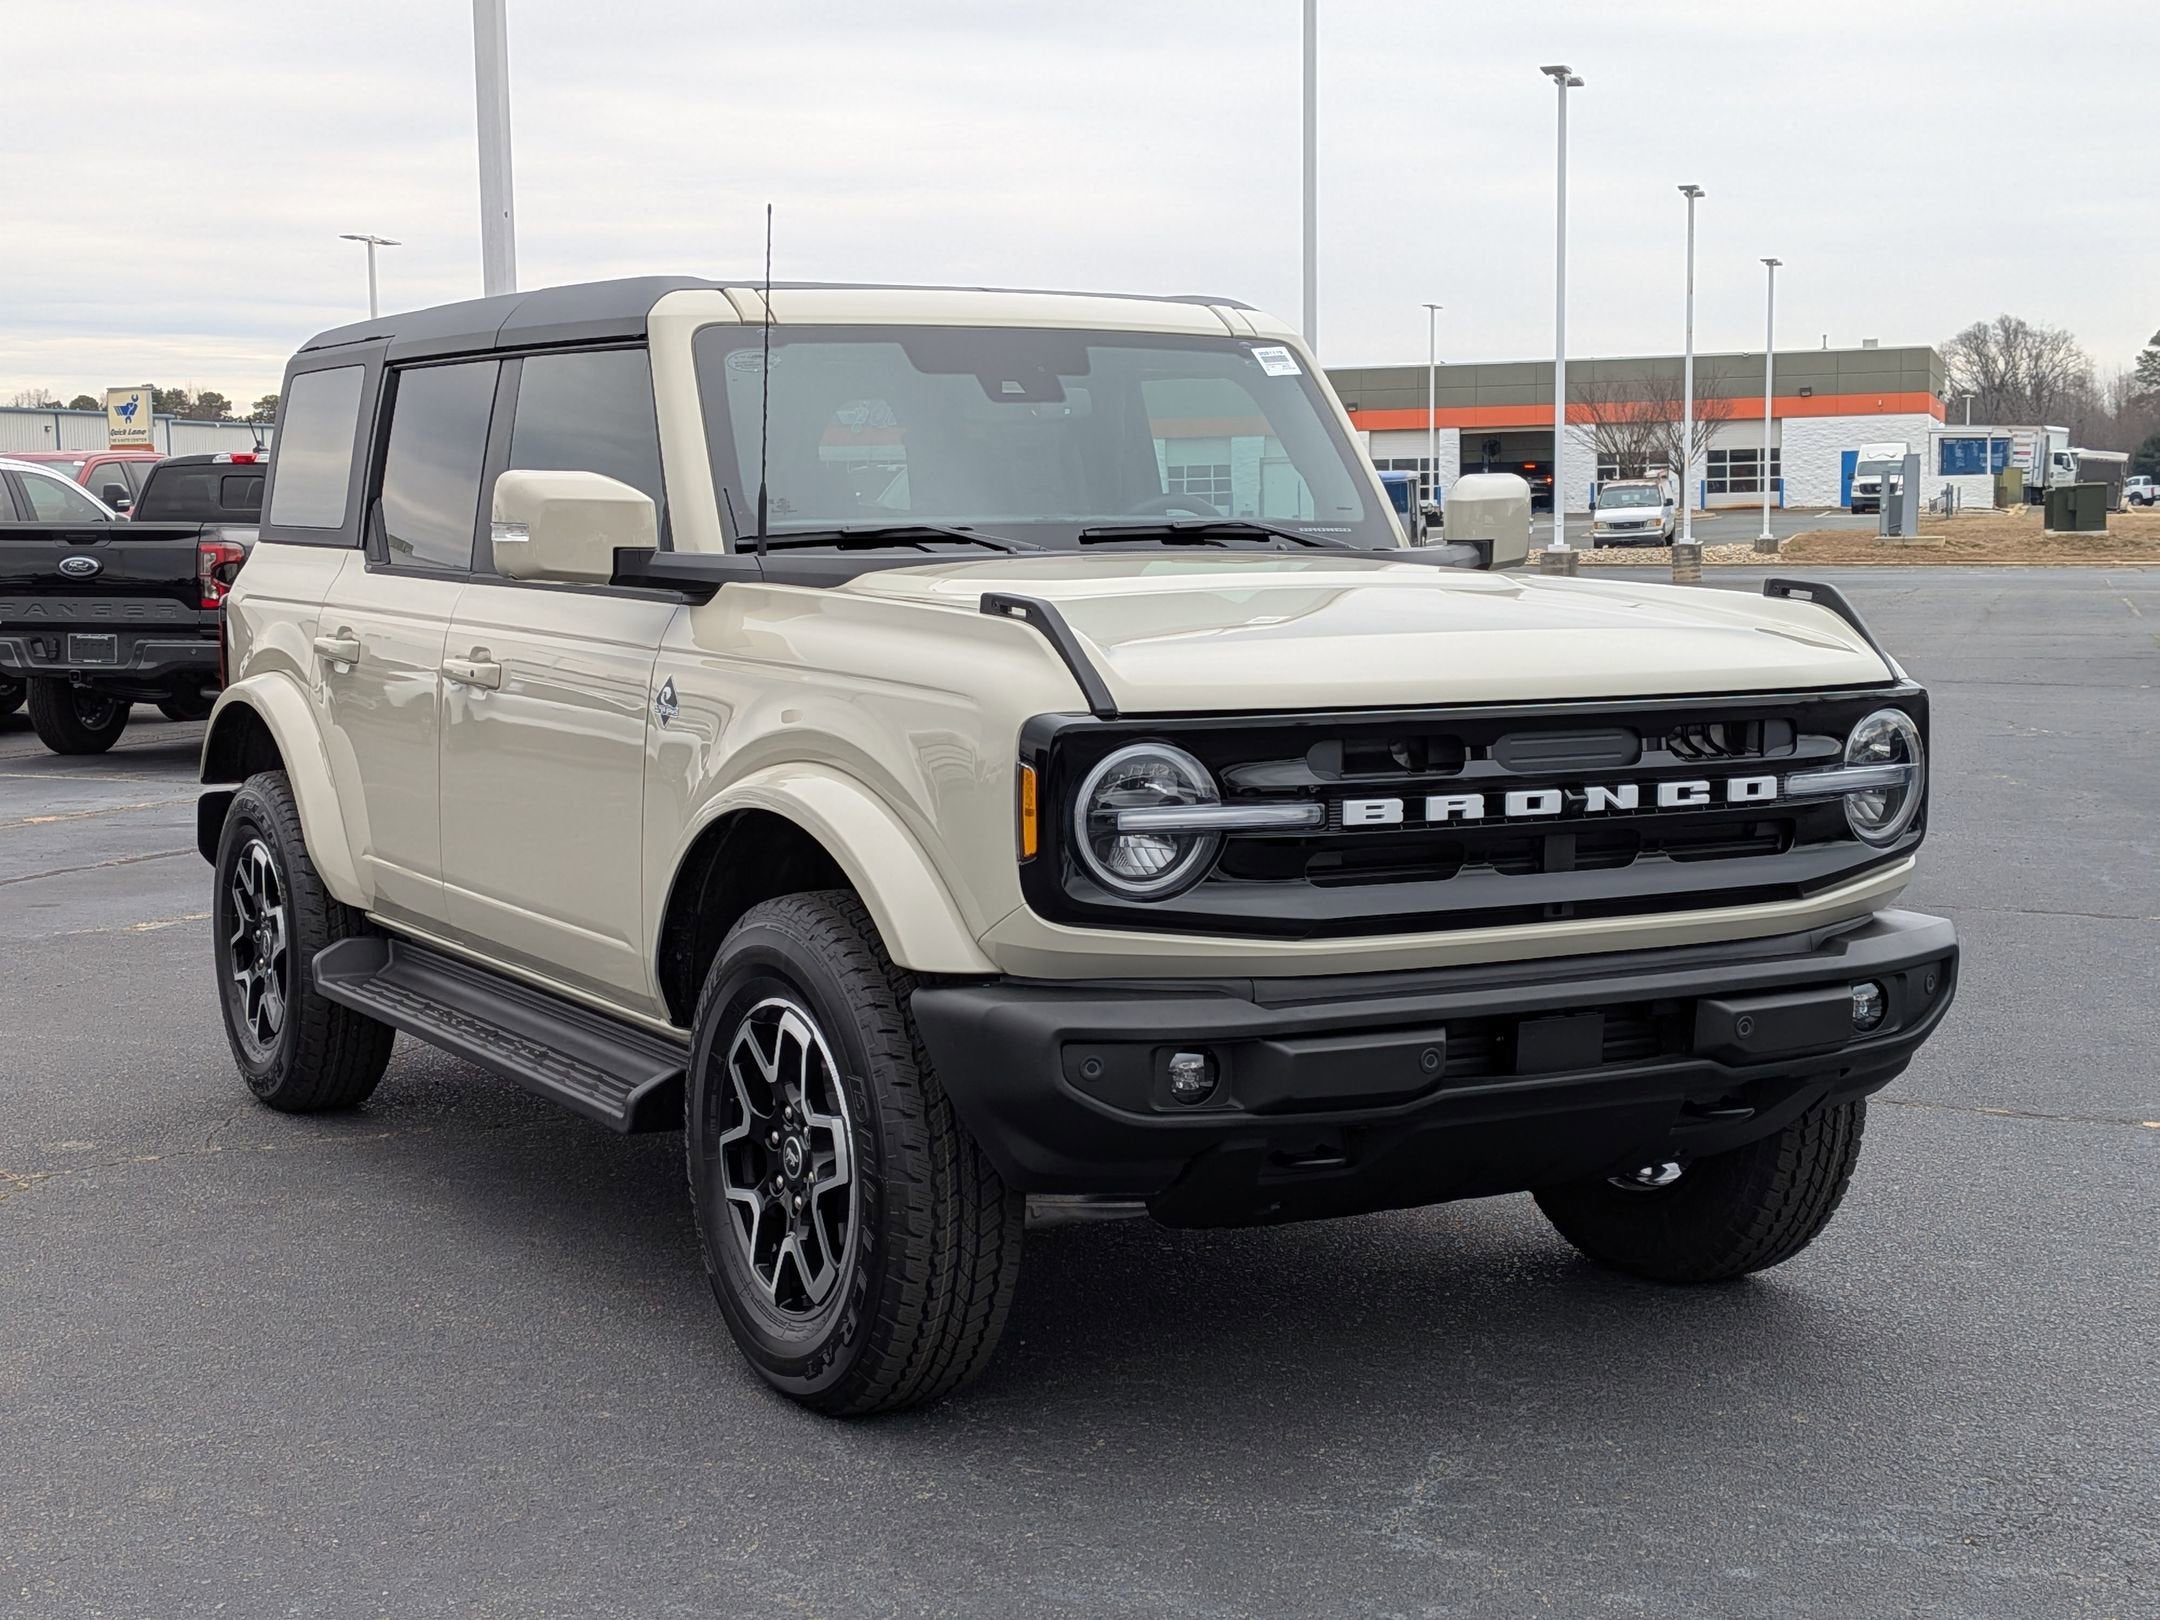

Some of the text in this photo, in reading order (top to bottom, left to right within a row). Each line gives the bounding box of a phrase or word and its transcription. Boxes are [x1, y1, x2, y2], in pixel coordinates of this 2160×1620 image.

[110, 428, 147, 437] Quick Lane
[1342, 775, 1778, 826] BRONCO
